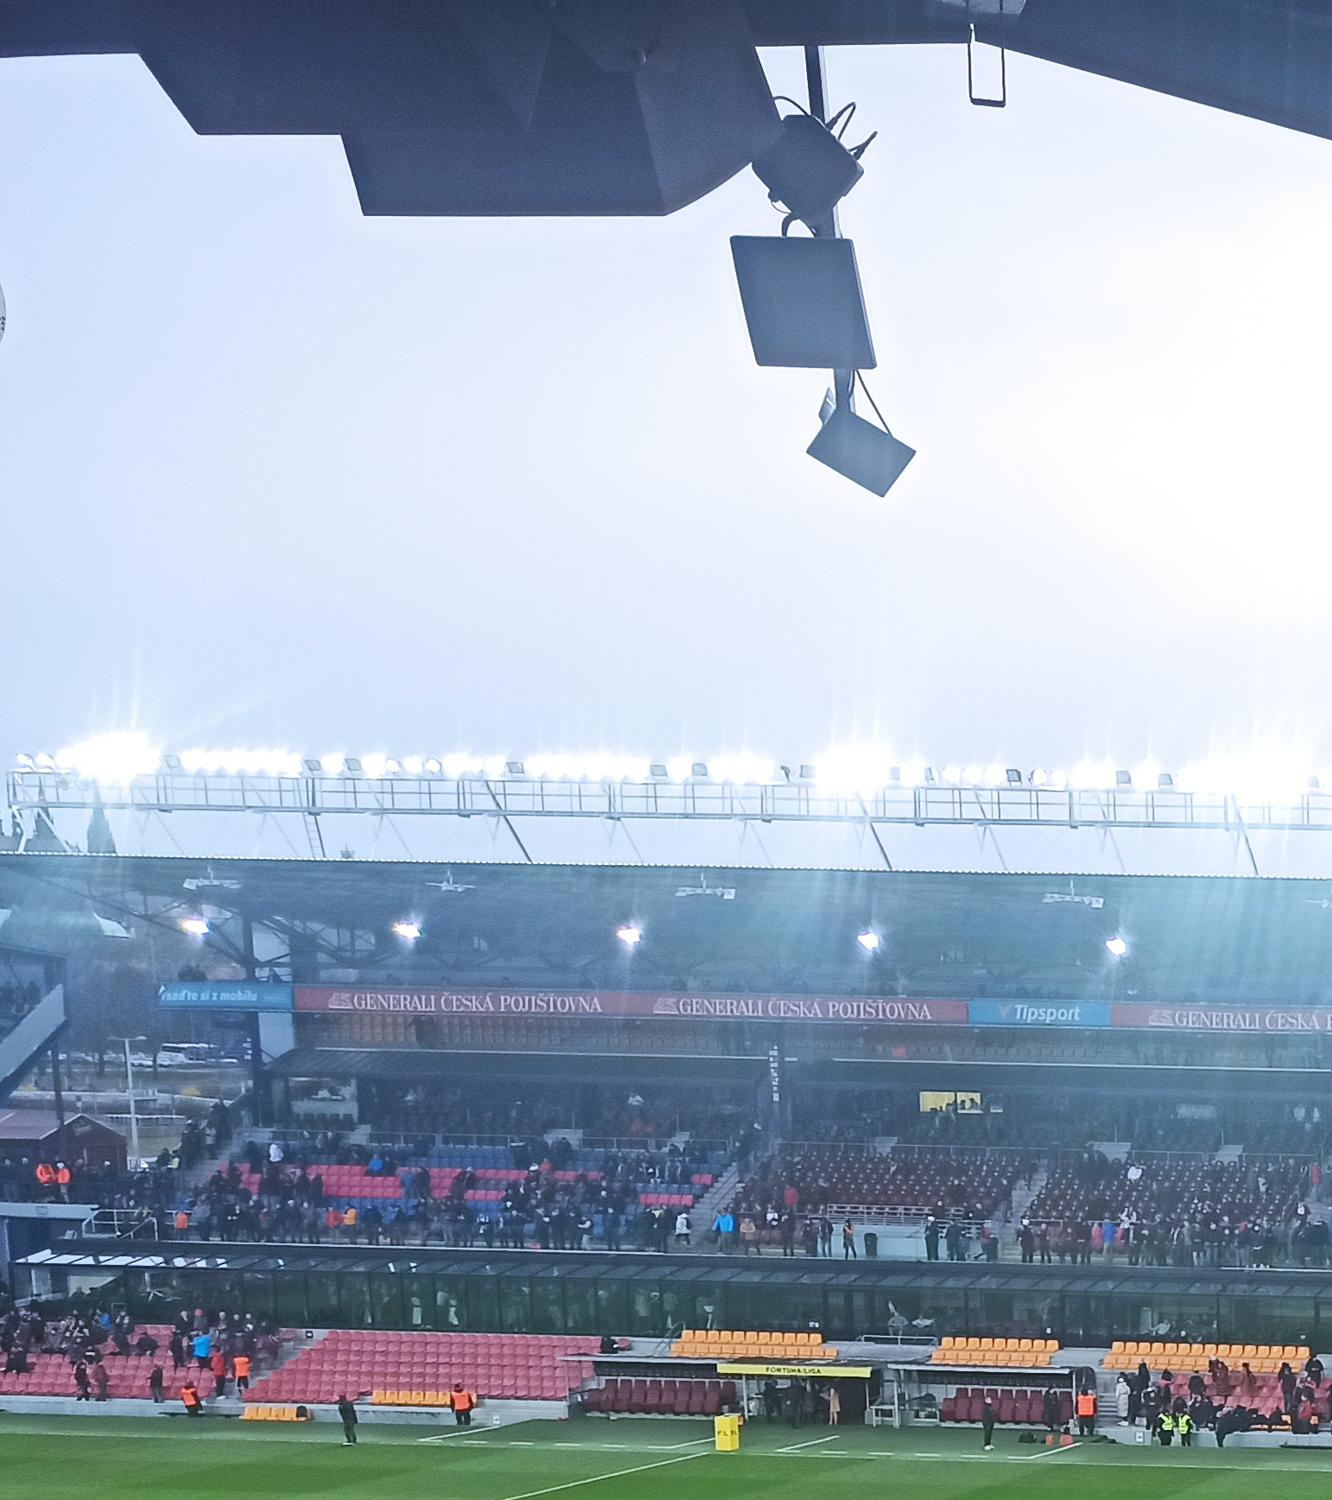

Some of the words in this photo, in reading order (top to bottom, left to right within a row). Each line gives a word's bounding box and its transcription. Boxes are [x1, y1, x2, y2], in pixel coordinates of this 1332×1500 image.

[352, 992, 437, 1012] GENERALI
[440, 989, 495, 1013] ČESKÁ
[499, 991, 604, 1014] POJIŠŤOVNA
[678, 998, 763, 1017] GENERALI
[768, 994, 823, 1019] ČESKÁ
[828, 998, 933, 1020] POJIŠŤOVNA
[1013, 1003, 1081, 1023] Tipsport
[1174, 1010, 1261, 1031] GENERALI
[1265, 1007, 1320, 1031] ČESKÁ
